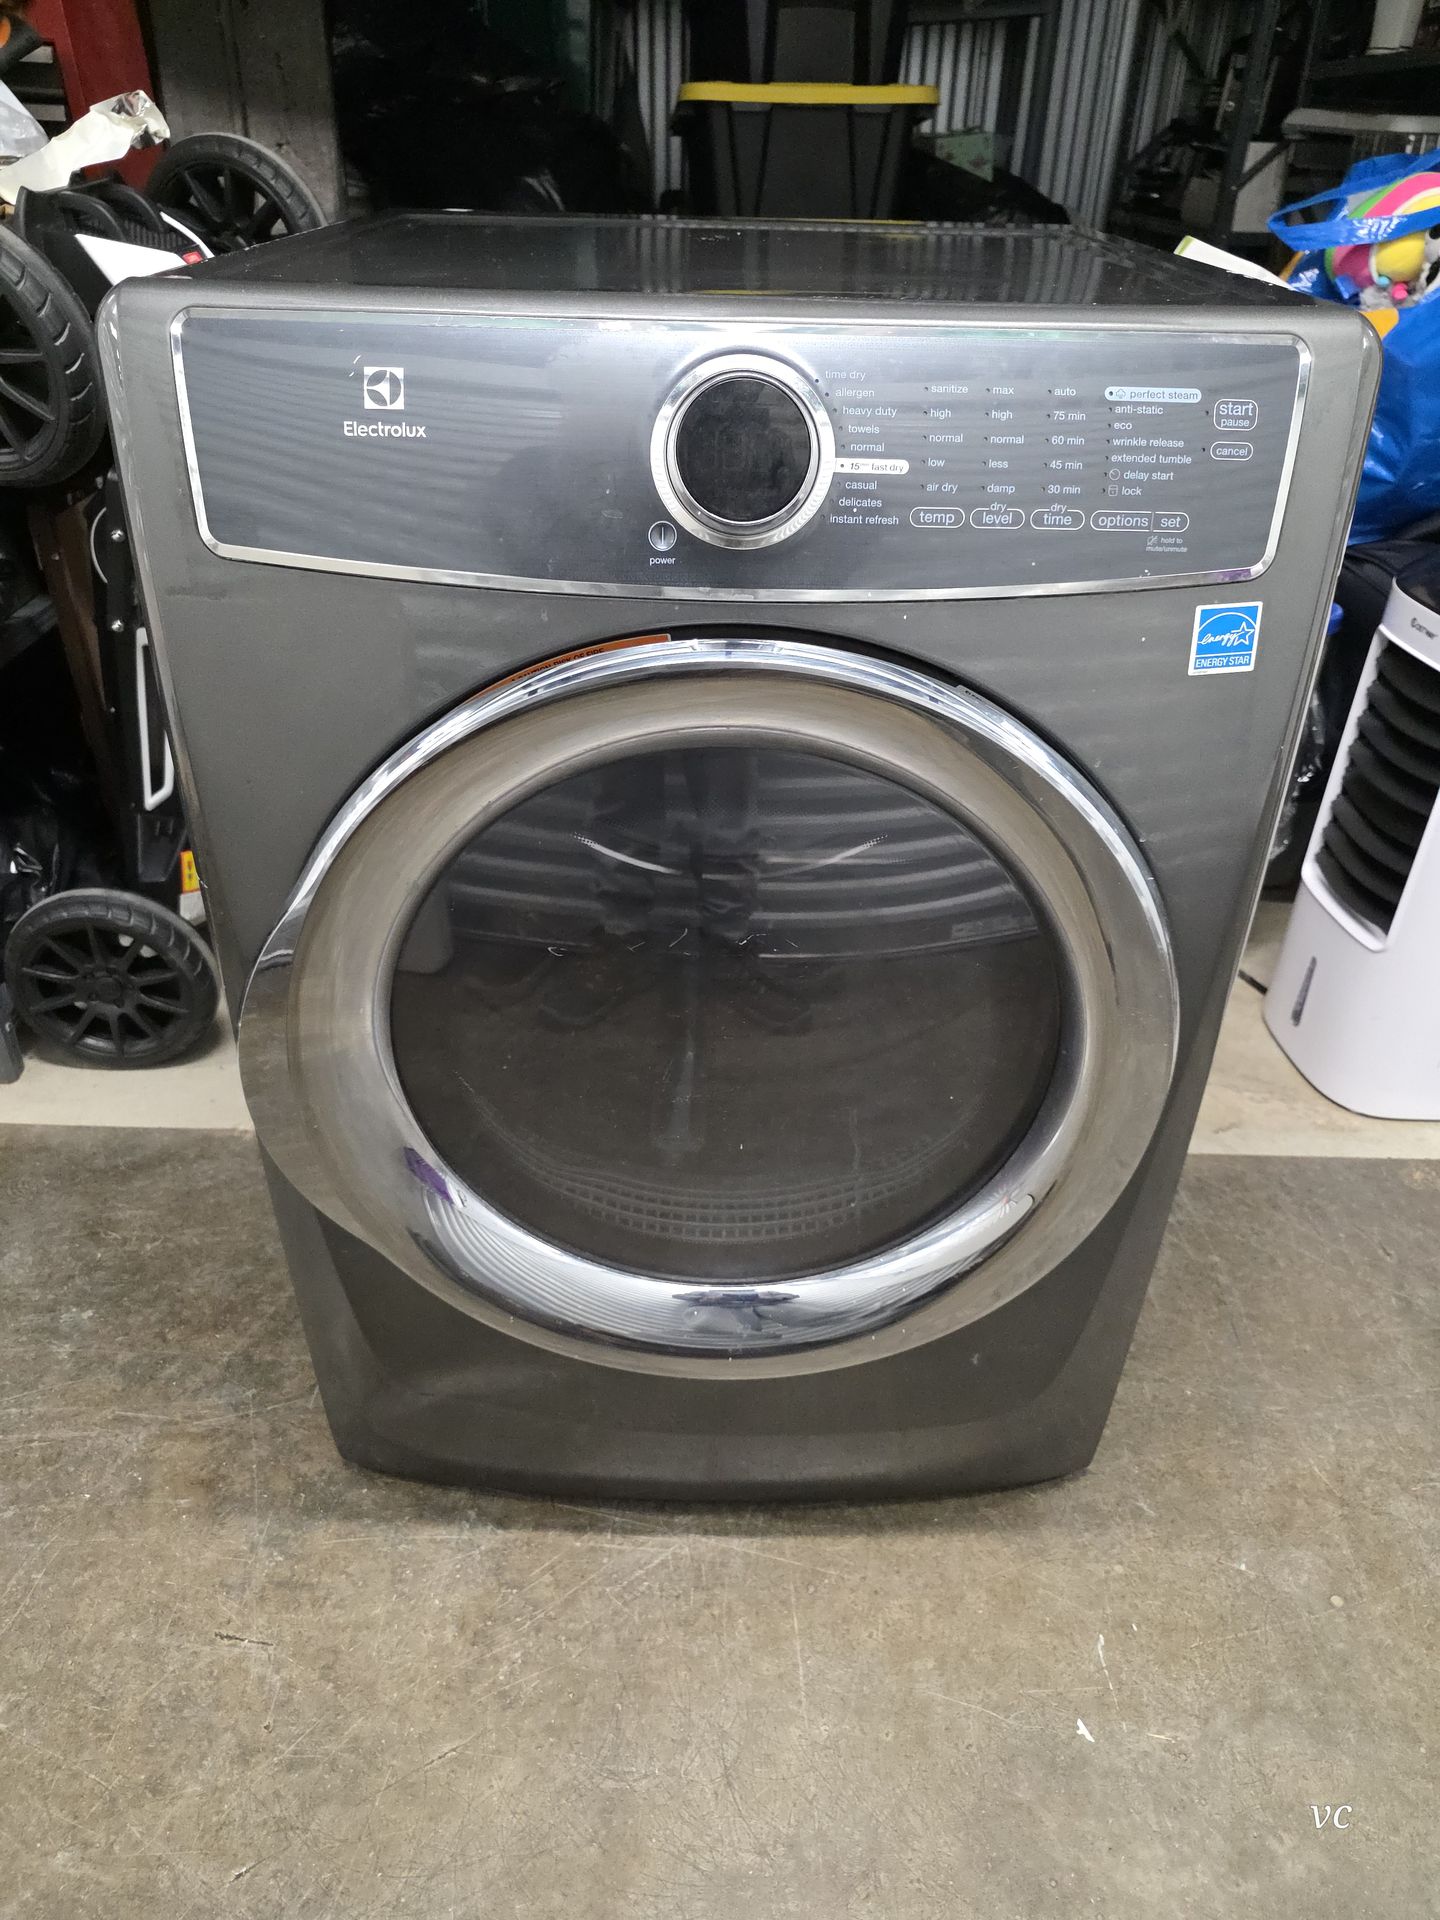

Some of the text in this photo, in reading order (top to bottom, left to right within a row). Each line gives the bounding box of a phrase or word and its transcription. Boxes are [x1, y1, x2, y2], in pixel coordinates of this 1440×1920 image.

[825, 370, 866, 382] time dry
[836, 388, 874, 398] allergen
[931, 384, 968, 394] sanitize
[992, 386, 1014, 394] max
[1054, 388, 1076, 396] auto
[1130, 390, 1198, 401] perfect steam
[842, 406, 898, 418] heavy duty
[930, 408, 952, 419] high
[1114, 405, 1164, 414] anti-static
[1219, 402, 1254, 416] start
[992, 410, 1013, 420] high
[1053, 412, 1086, 420] 75 min
[1114, 422, 1132, 430] eco
[1220, 418, 1250, 429] pause
[343, 421, 426, 438] Electrolux
[848, 425, 880, 434] towels
[929, 433, 964, 442] normal
[990, 435, 1024, 444] normal
[1052, 436, 1084, 445] 60 min
[850, 442, 884, 452] normal
[1112, 438, 1184, 448] wrinkle release
[1216, 446, 1248, 456] cancel
[928, 458, 945, 467] low
[988, 459, 1008, 468] less
[1111, 454, 1192, 464] extended tumble
[850, 462, 860, 470] 15
[872, 462, 888, 471] fast
[890, 464, 904, 474] dry
[1050, 460, 1083, 470] 45 min
[1124, 470, 1174, 482] delay start
[846, 480, 877, 490] casual
[926, 482, 958, 494] air dry
[987, 484, 1016, 494] damp
[1048, 484, 1080, 494] 30 min
[1122, 486, 1142, 496] lock
[838, 498, 882, 507] delicates
[990, 502, 1006, 512] dry
[1050, 503, 1066, 514] dry
[830, 514, 898, 525] instant refresh
[920, 511, 954, 526] temp
[982, 512, 1013, 524] level
[1043, 513, 1072, 526] time
[1098, 514, 1148, 529] options
[1160, 516, 1181, 528] set
[650, 558, 676, 566] power
[1196, 656, 1250, 668] ENERGY STAR
